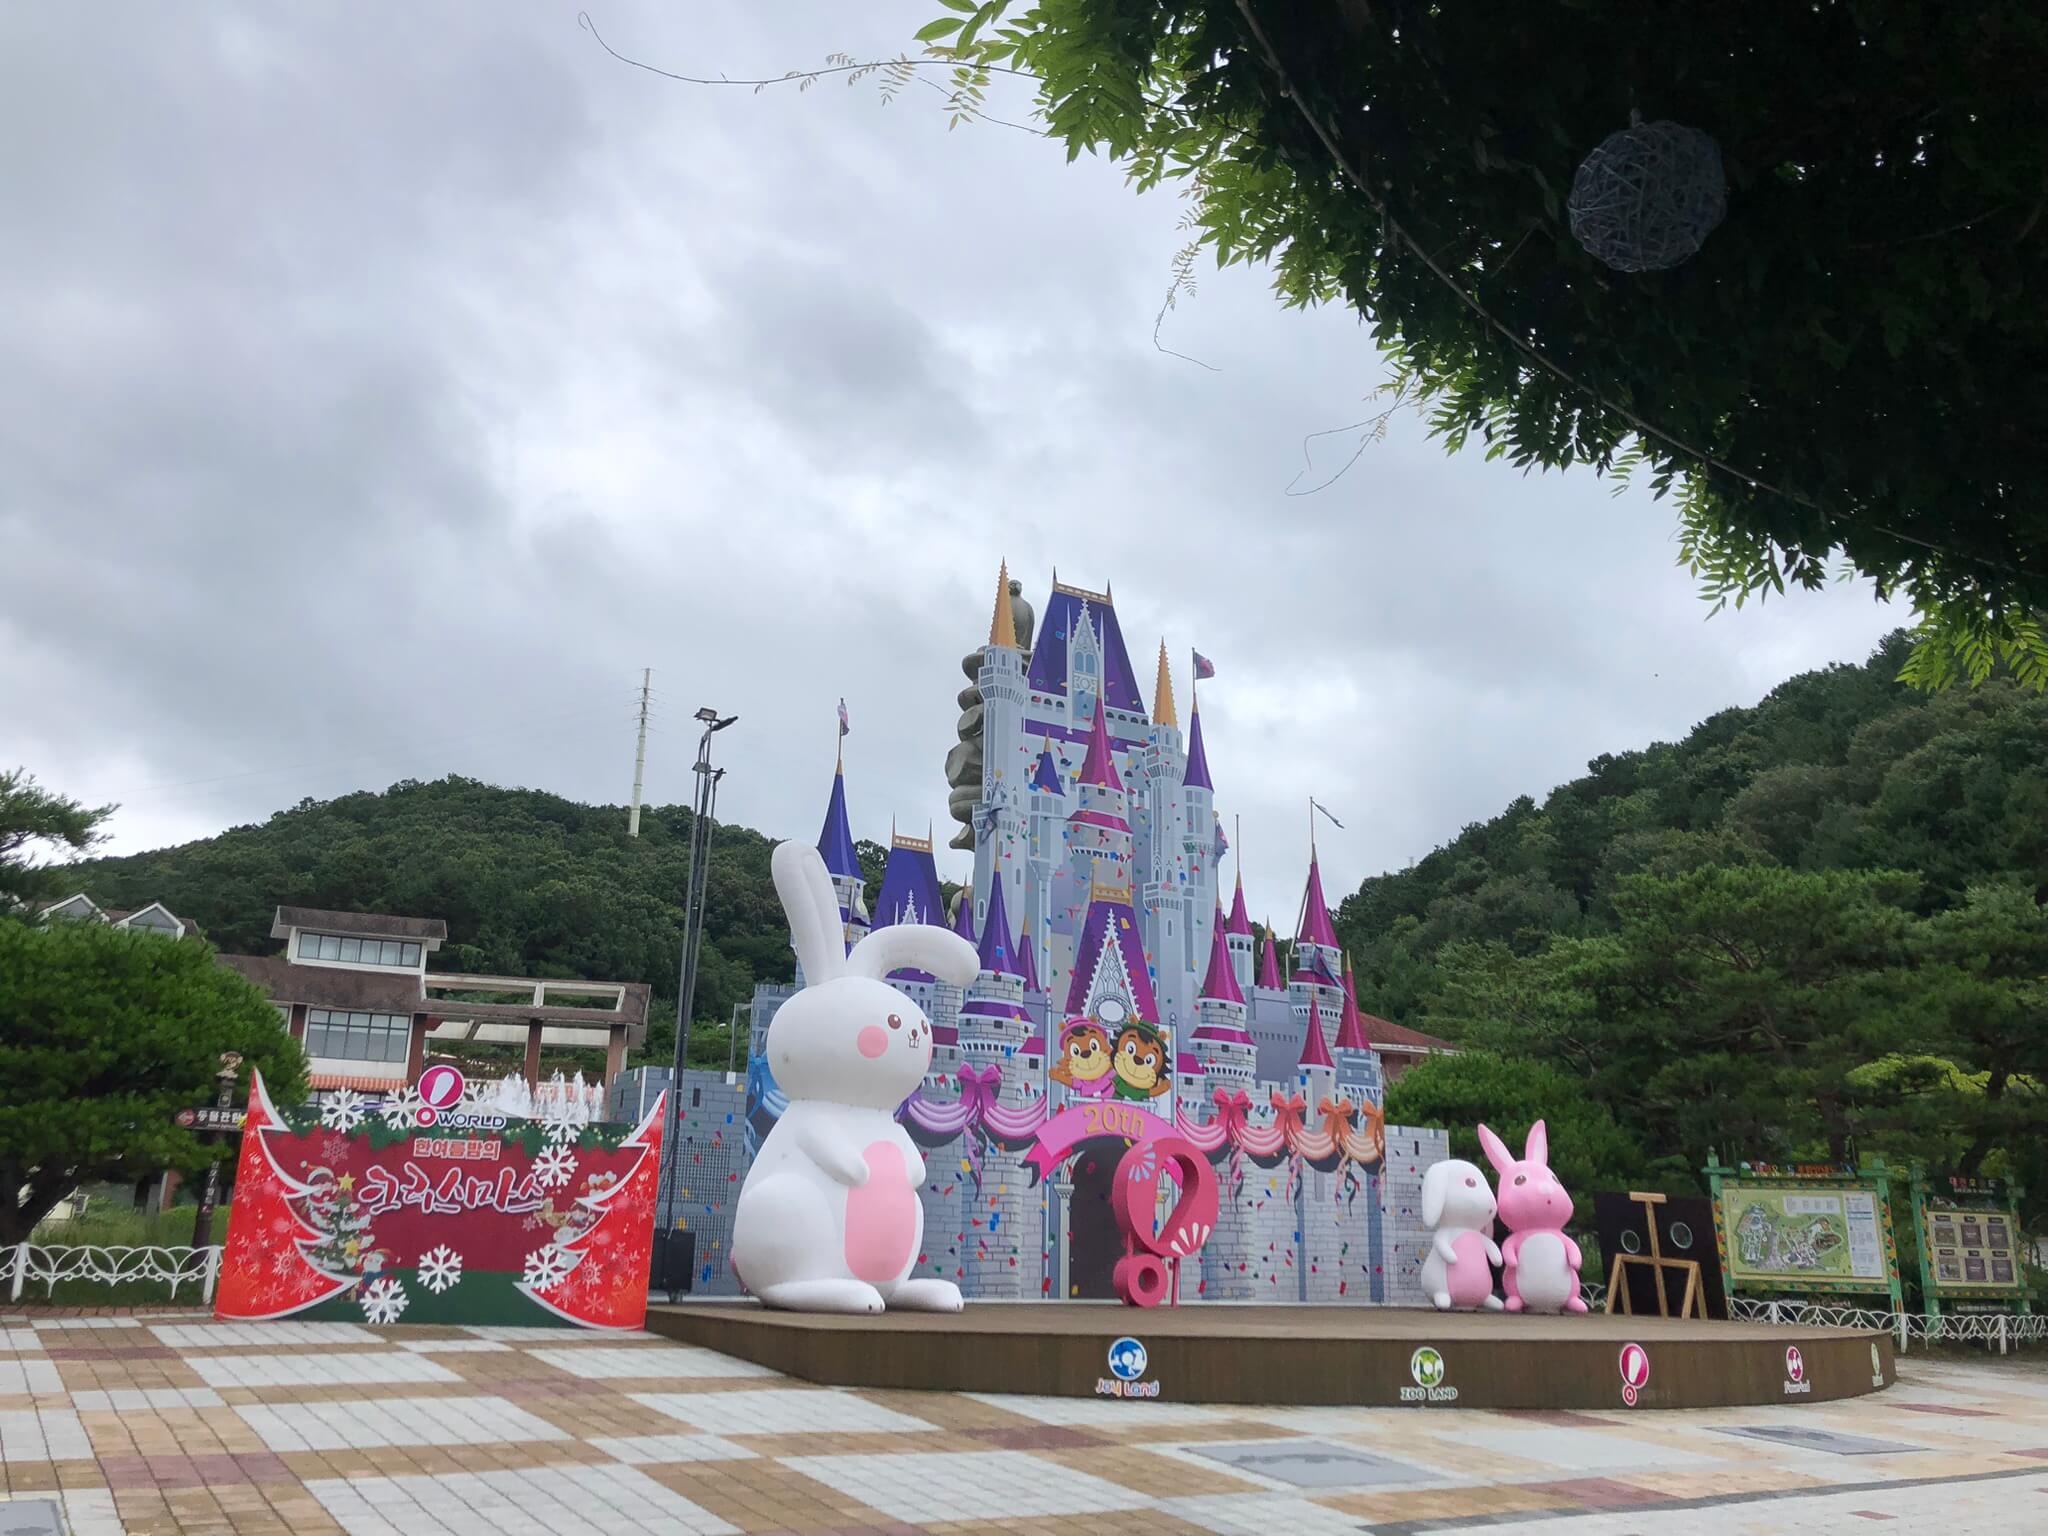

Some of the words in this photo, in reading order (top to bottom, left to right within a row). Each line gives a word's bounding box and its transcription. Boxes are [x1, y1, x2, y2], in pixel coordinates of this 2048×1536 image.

[438, 1112, 506, 1129] WORLD
[1083, 1103, 1145, 1137] 20th
[358, 1161, 544, 1215] 크리스마스
[1123, 1380, 1160, 1397] Land
[1400, 1386, 1426, 1401] ZOO
[1427, 1386, 1459, 1401] LAND
